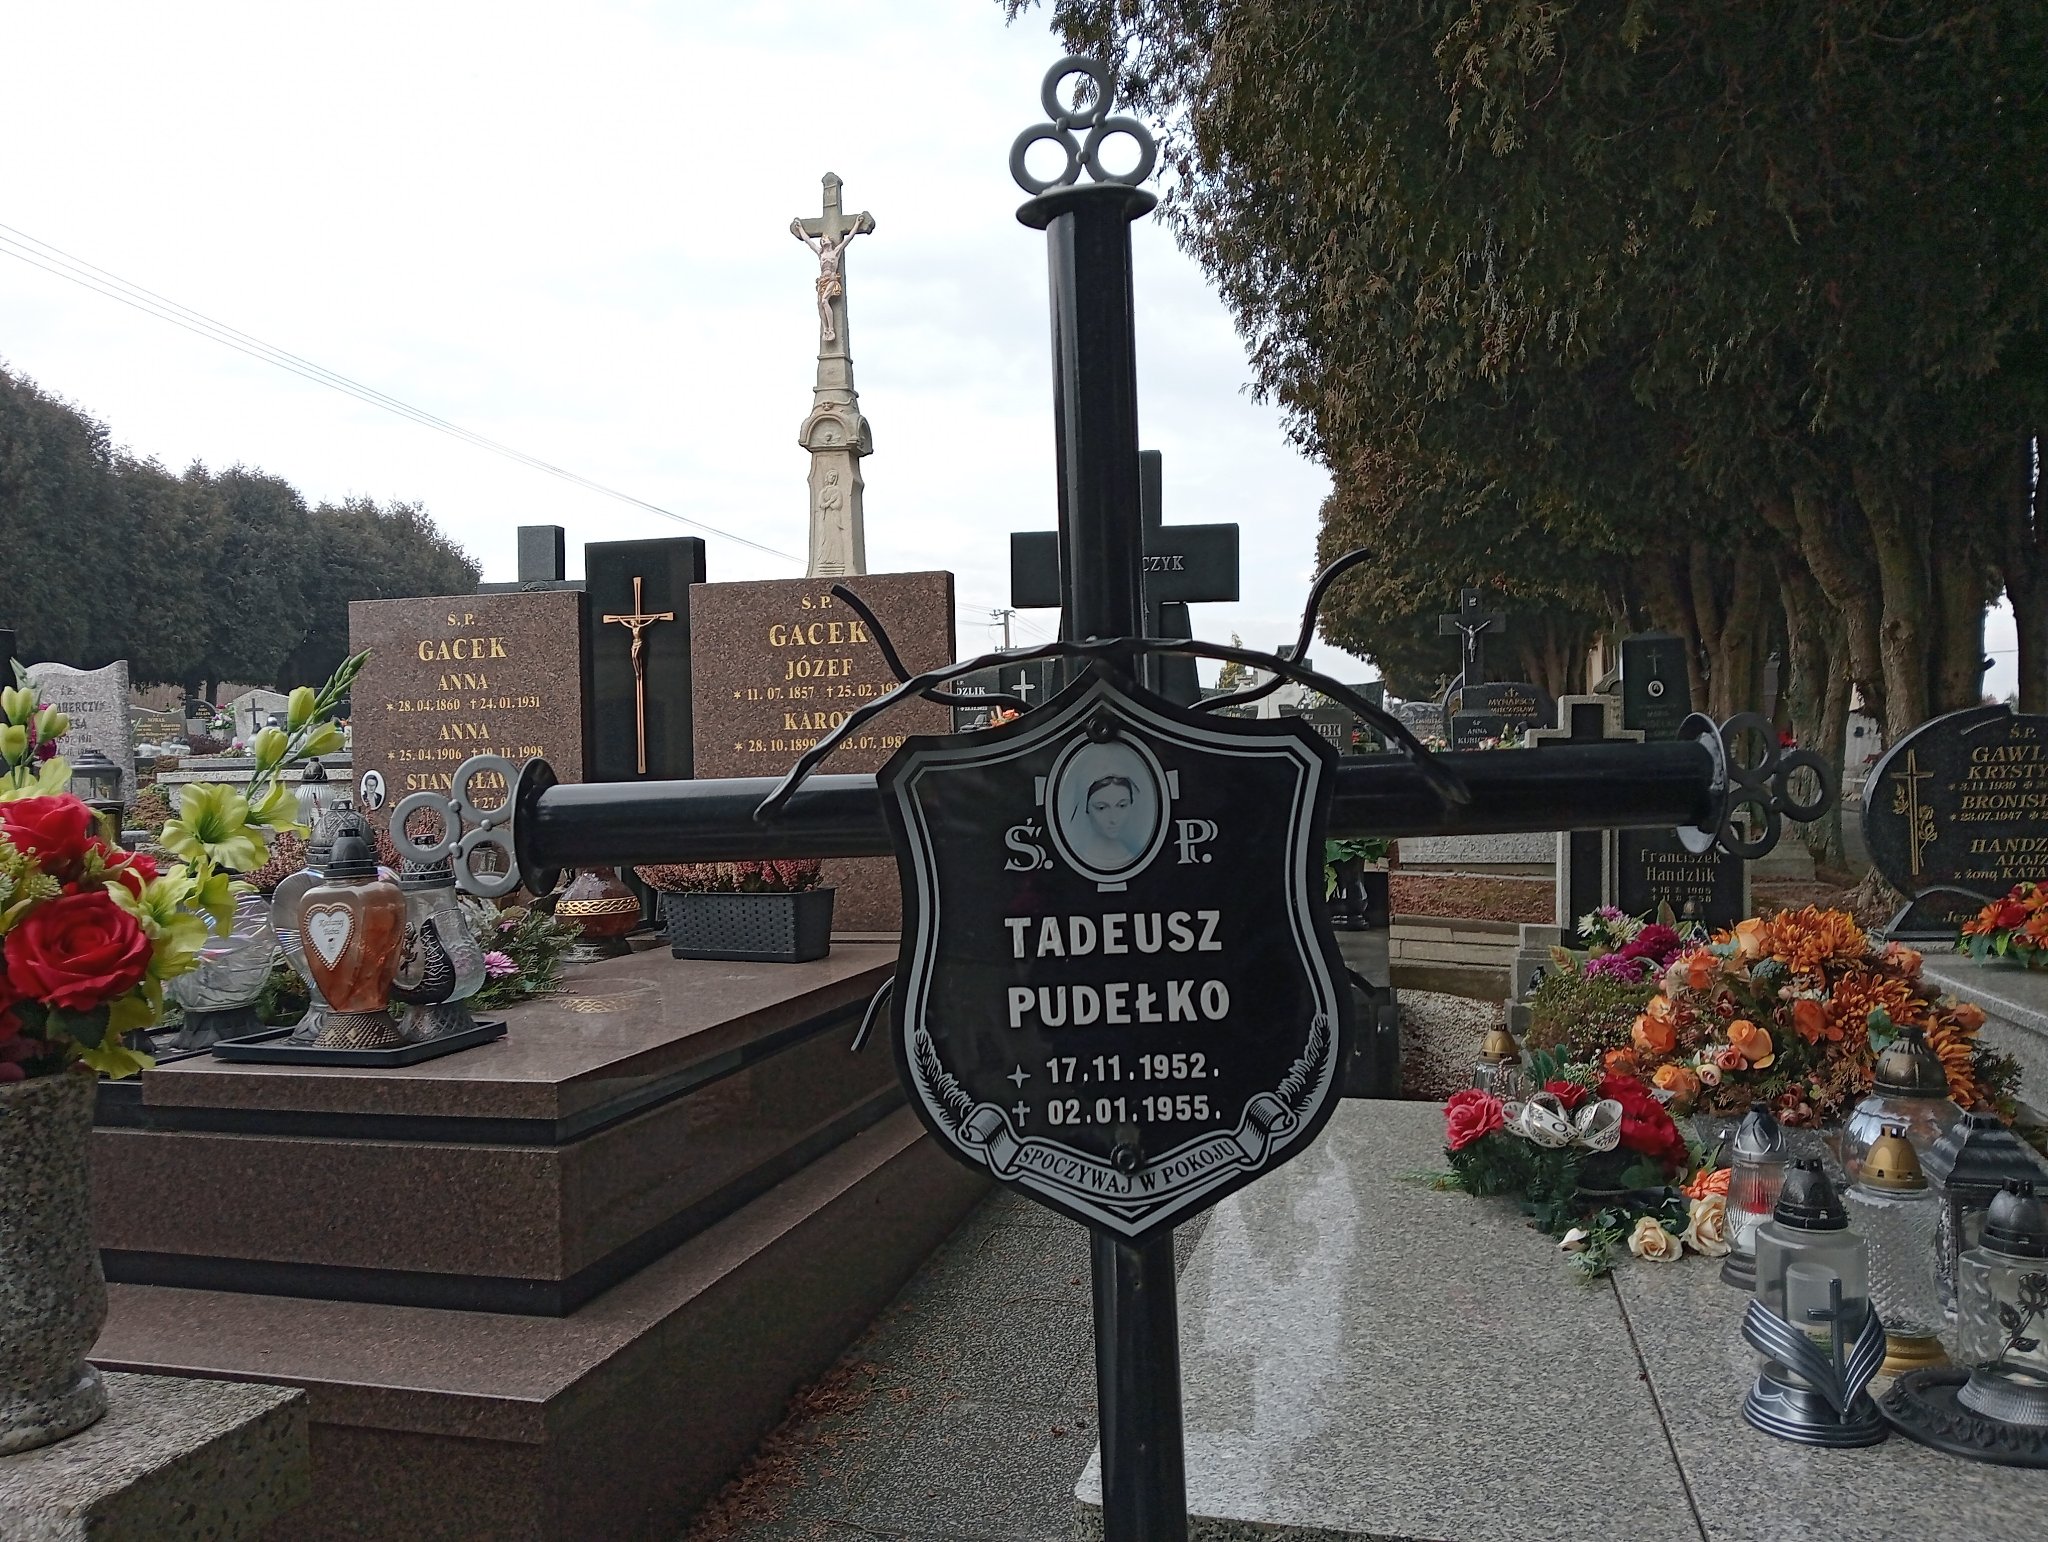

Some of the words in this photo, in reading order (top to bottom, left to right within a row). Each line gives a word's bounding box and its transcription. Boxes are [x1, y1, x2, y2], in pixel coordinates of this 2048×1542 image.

[769, 620, 868, 647] GACEK
[418, 637, 506, 661] GACEK
[785, 655, 854, 680] JÓZEF
[437, 673, 489, 690] ANNA
[439, 723, 489, 740] ANNA
[784, 711, 853, 730] KARO
[1174, 819, 1219, 864] P.
[1646, 866, 1715, 883] Handzlik
[1004, 909, 1222, 959] TADEUSZ
[1007, 979, 1230, 1028] PUDEŁKO
[1019, 1147, 1133, 1194] SPOCZYWAJ
[1138, 1174, 1157, 1192] W
[1161, 1140, 1236, 1185] POKOJU
